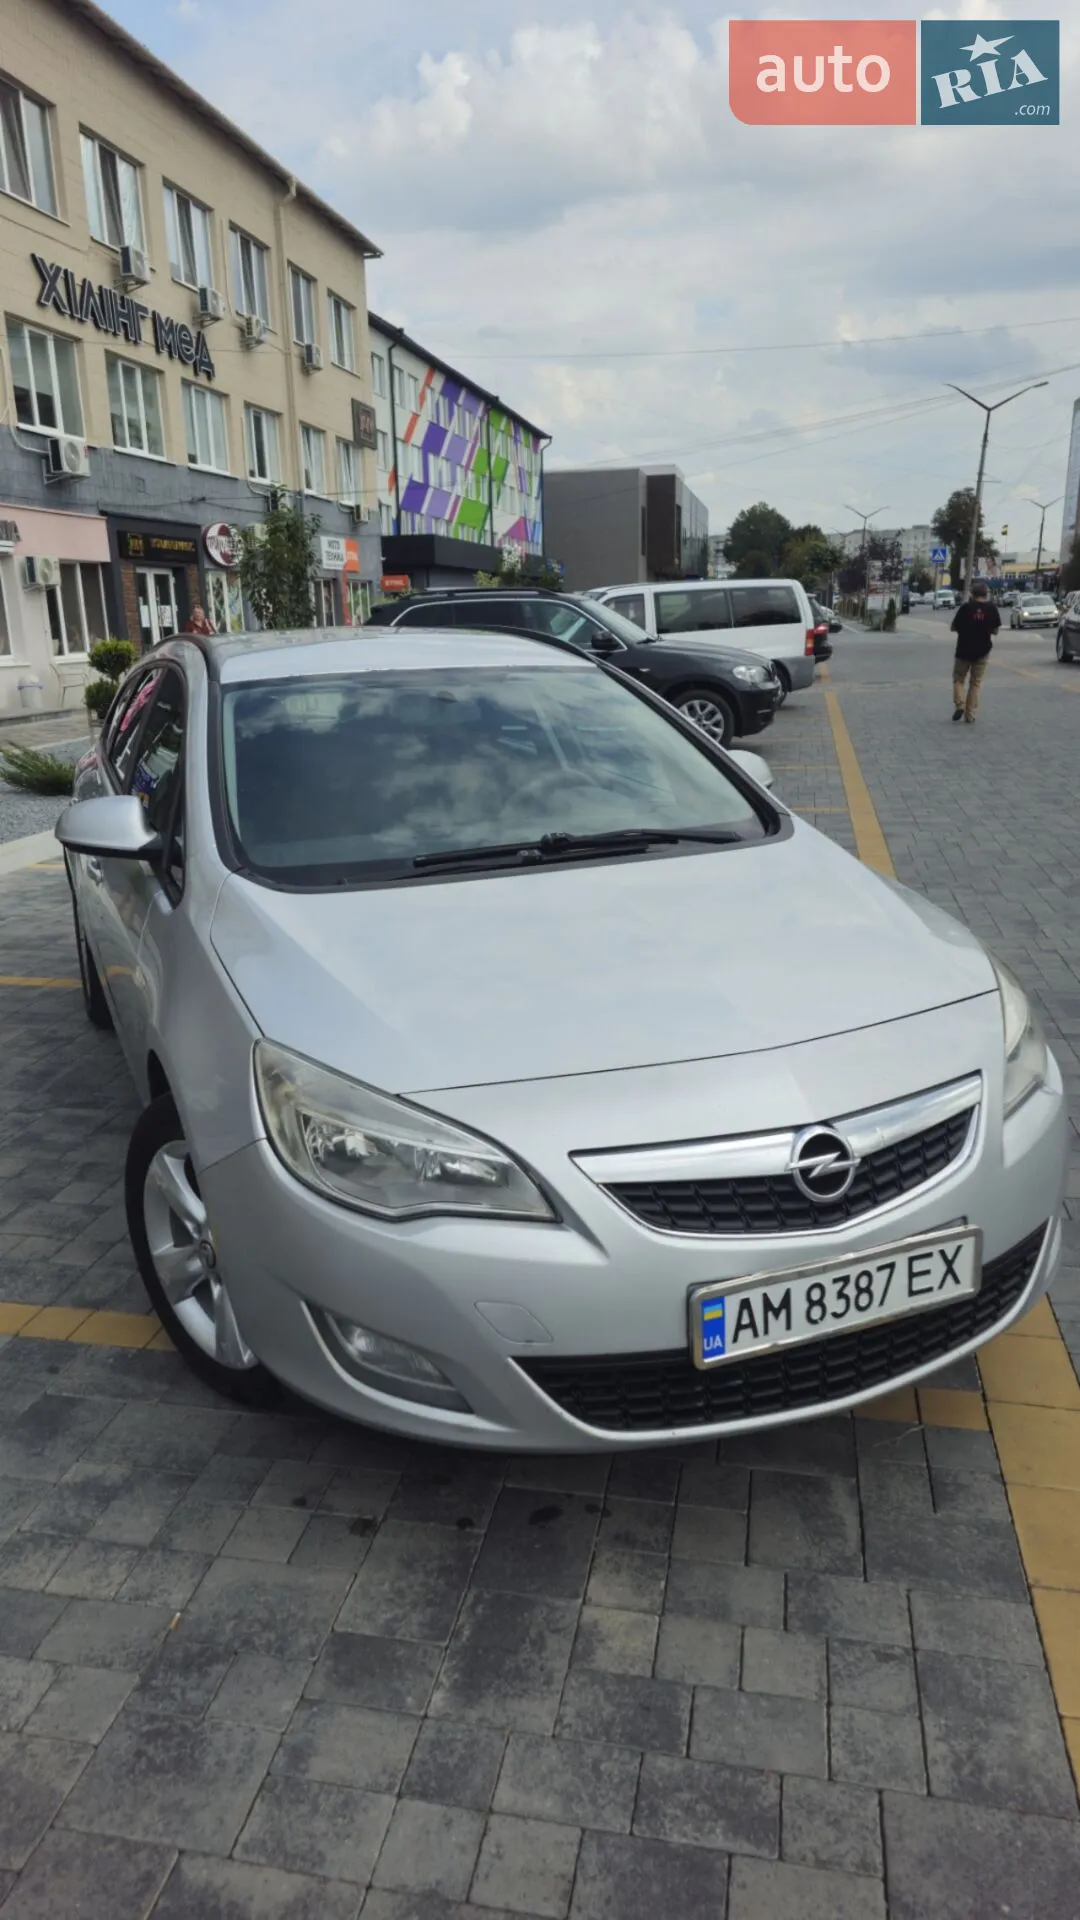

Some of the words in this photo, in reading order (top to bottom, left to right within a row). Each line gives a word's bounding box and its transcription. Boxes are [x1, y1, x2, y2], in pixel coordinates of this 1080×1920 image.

[31, 253, 151, 344] ХІЛІНГ
[703, 1336, 723, 1352] UA
[731, 1287, 792, 1345] AM
[805, 1261, 897, 1325] 8387
[907, 1244, 964, 1298] EX
